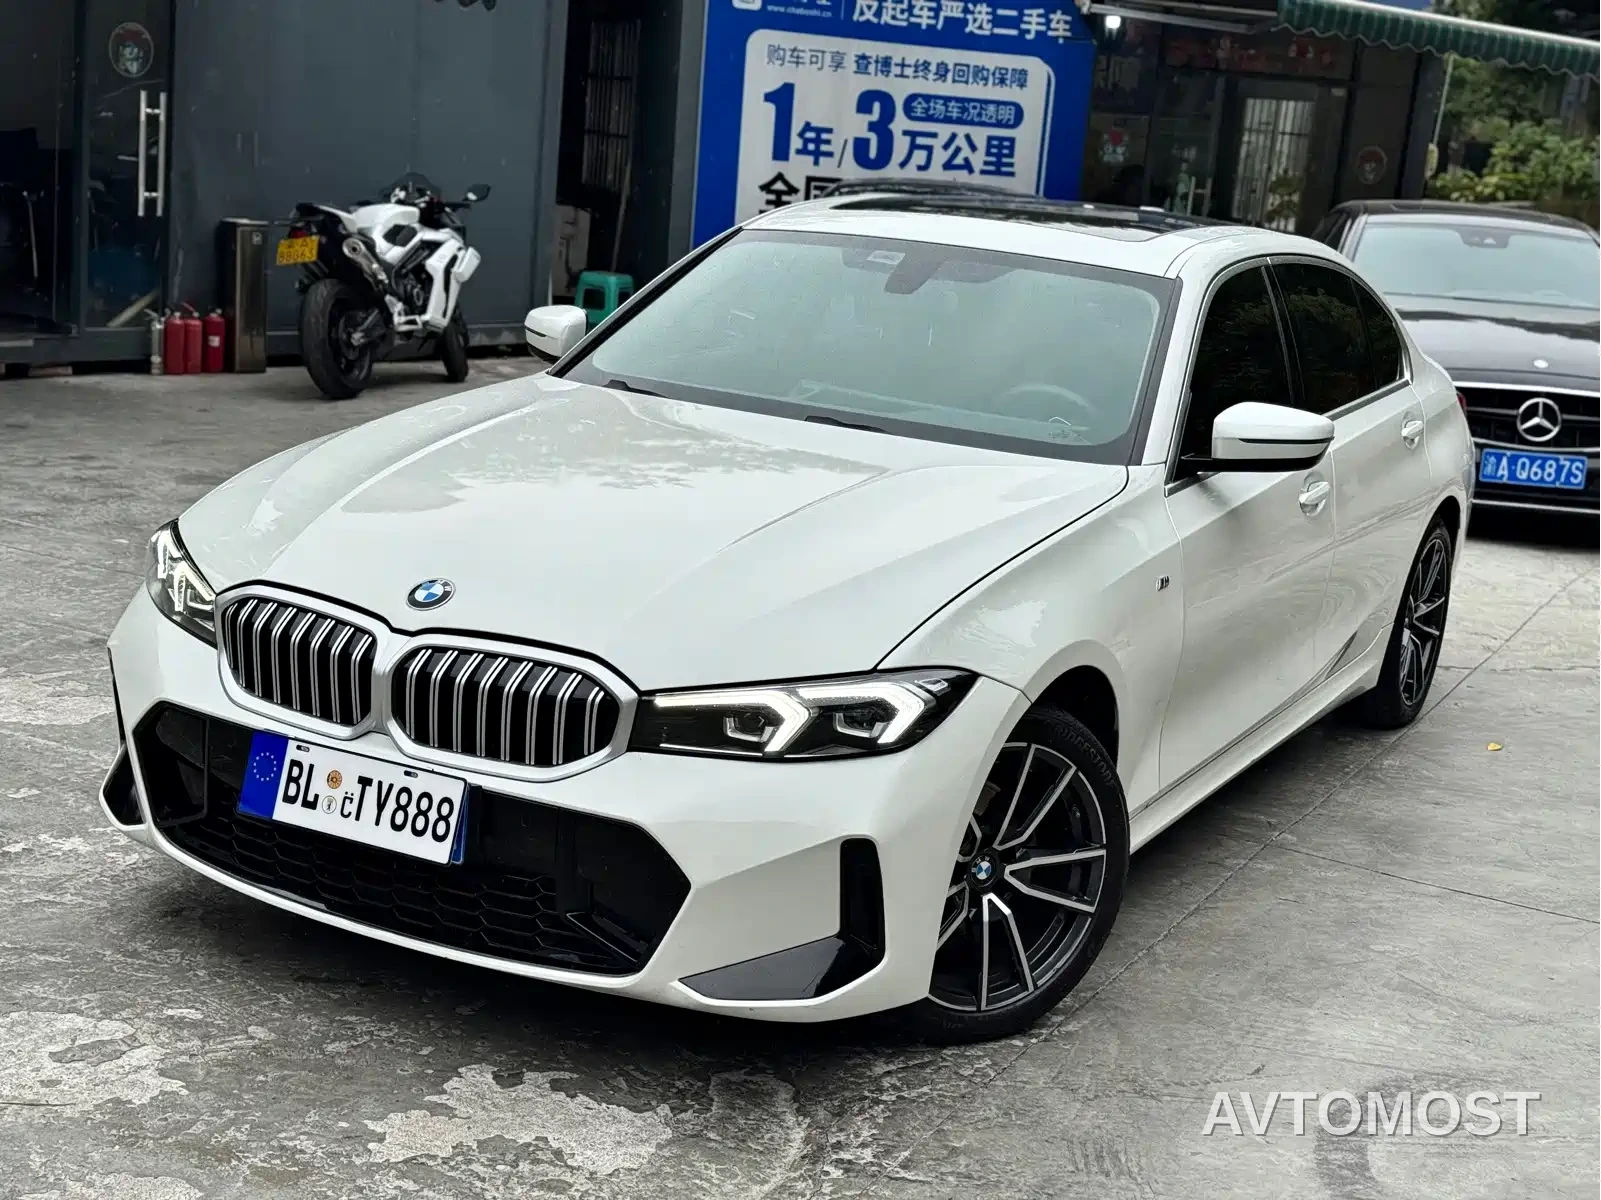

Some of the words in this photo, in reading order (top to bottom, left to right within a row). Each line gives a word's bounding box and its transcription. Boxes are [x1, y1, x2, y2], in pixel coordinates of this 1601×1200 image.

[766, 44, 847, 72] 购车可享
[853, 53, 1029, 90] 查博士终身回购保障
[911, 97, 1016, 125] 全场车况透明
[282, 759, 320, 811] BL
